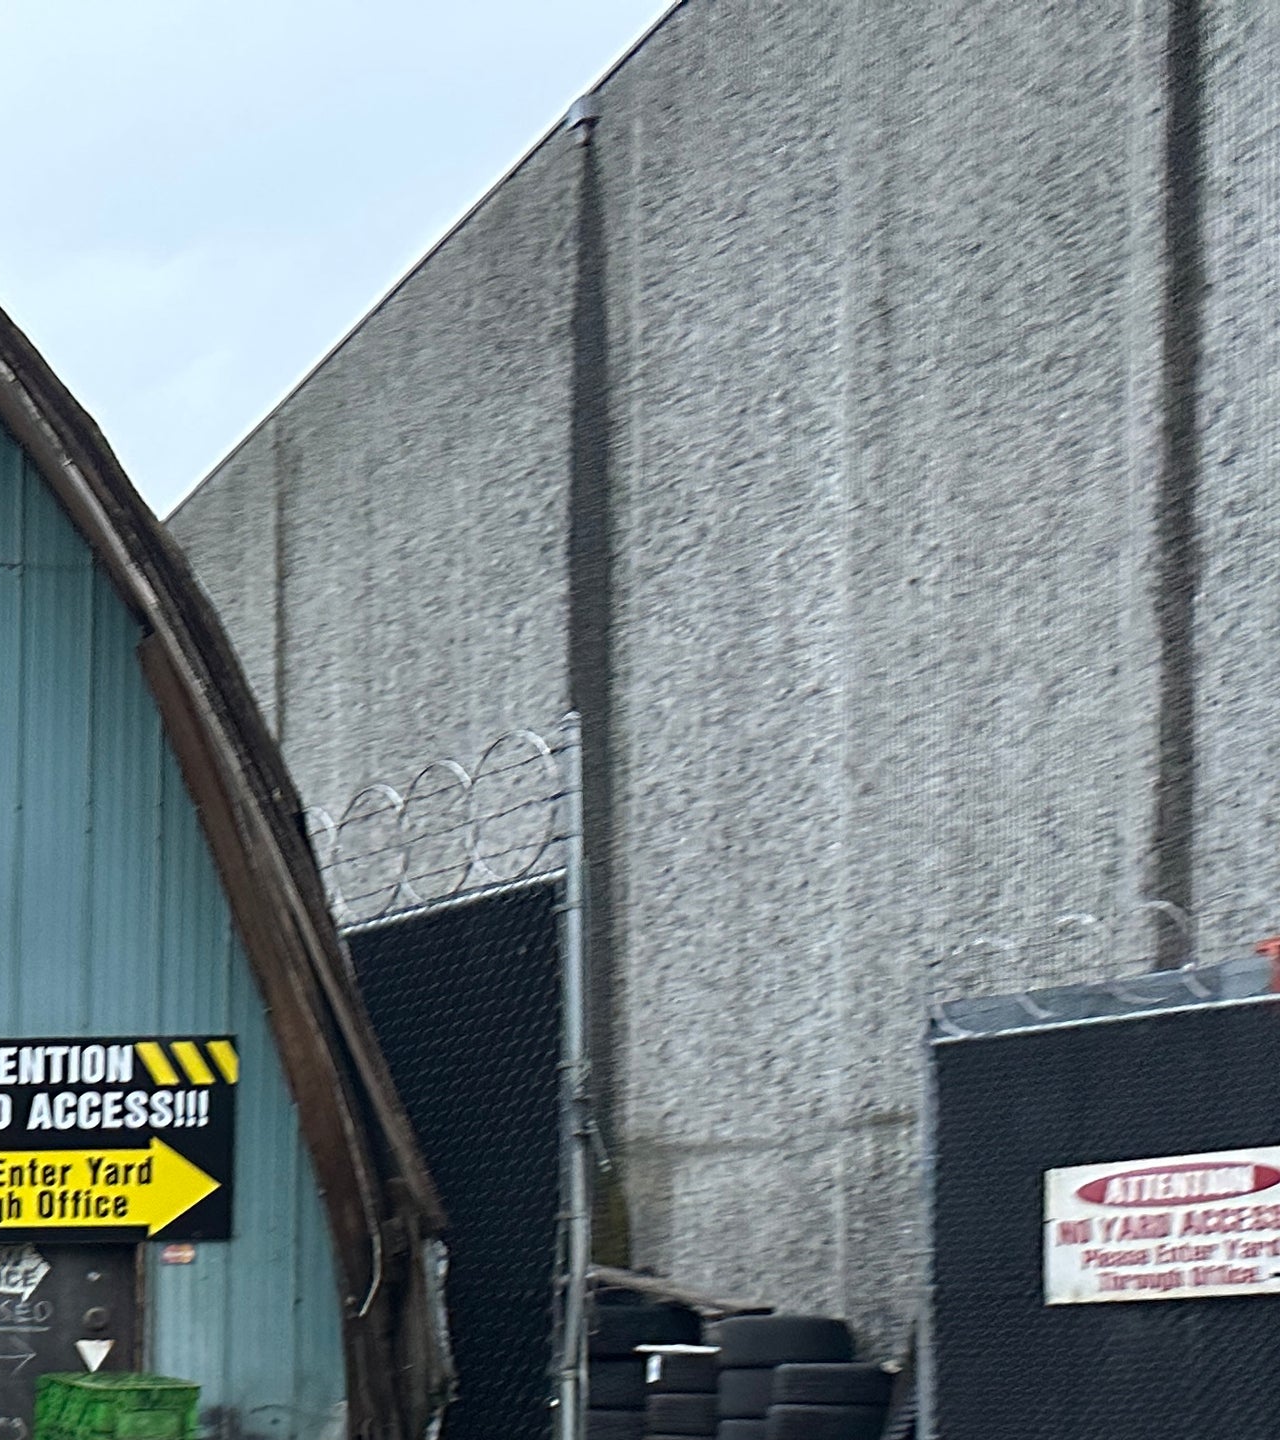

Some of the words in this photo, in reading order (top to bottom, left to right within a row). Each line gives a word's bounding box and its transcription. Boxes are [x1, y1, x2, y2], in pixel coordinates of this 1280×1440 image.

[26, 1089, 210, 1131] ACCESS!!!
[86, 1155, 154, 1186] Yard
[41, 1191, 130, 1219] Office
